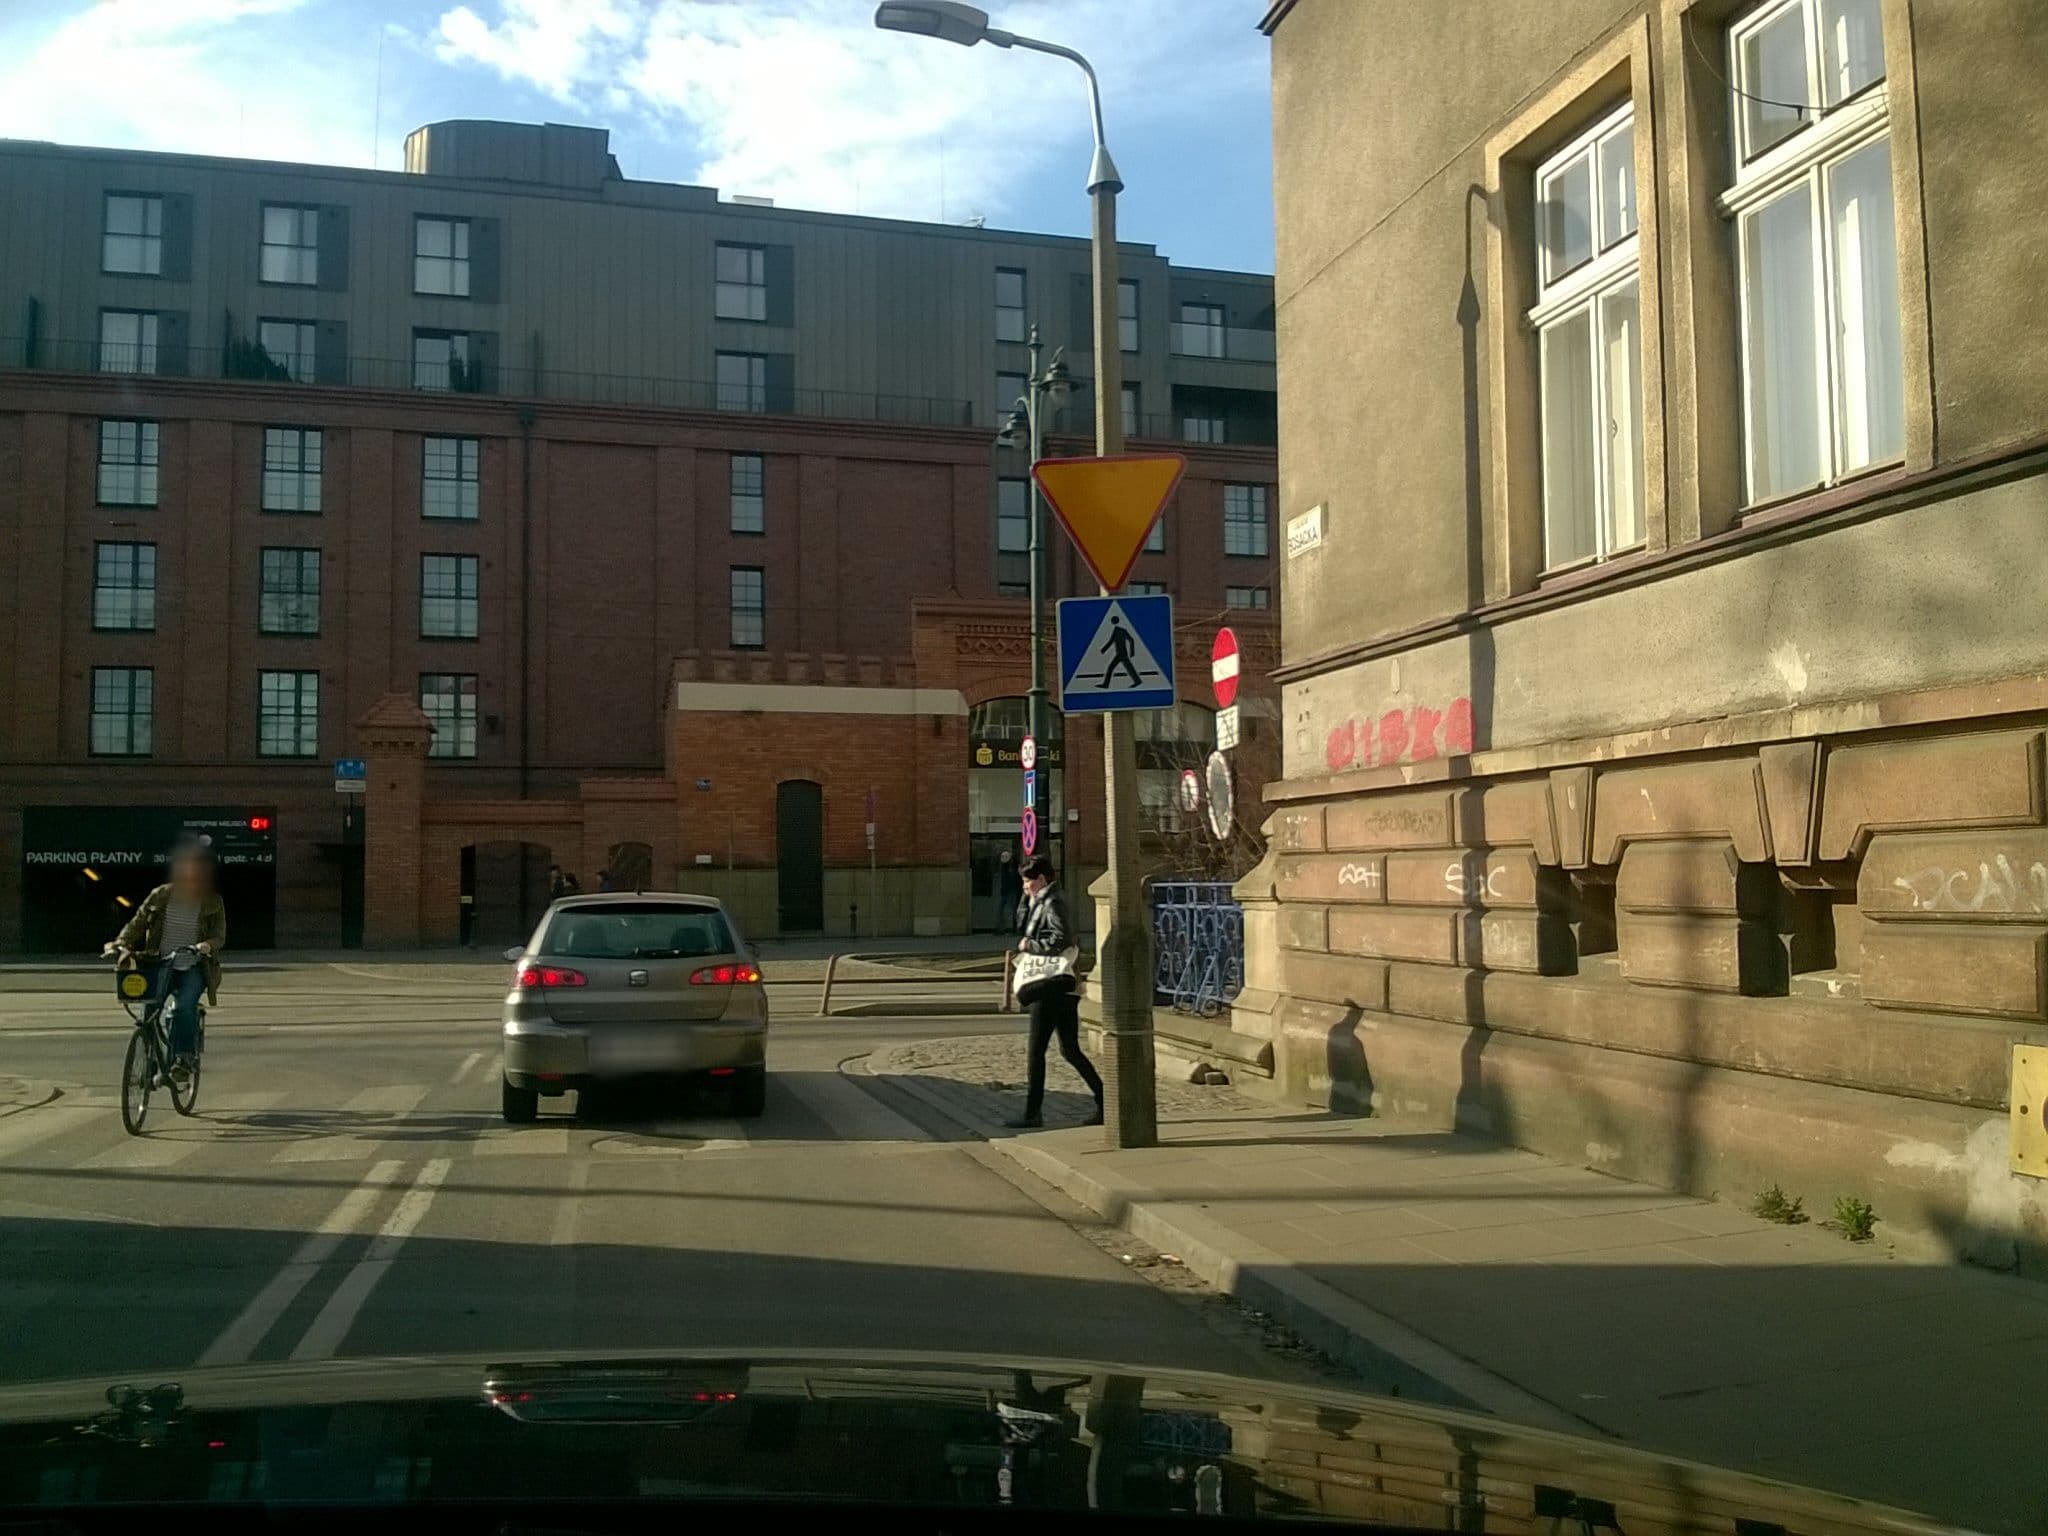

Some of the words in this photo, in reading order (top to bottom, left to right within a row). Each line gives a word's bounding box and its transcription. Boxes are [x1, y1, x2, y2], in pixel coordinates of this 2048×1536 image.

[998, 750, 1020, 761] Ban
[26, 851, 87, 863] PARKING
[90, 851, 143, 863] PŁATNY
